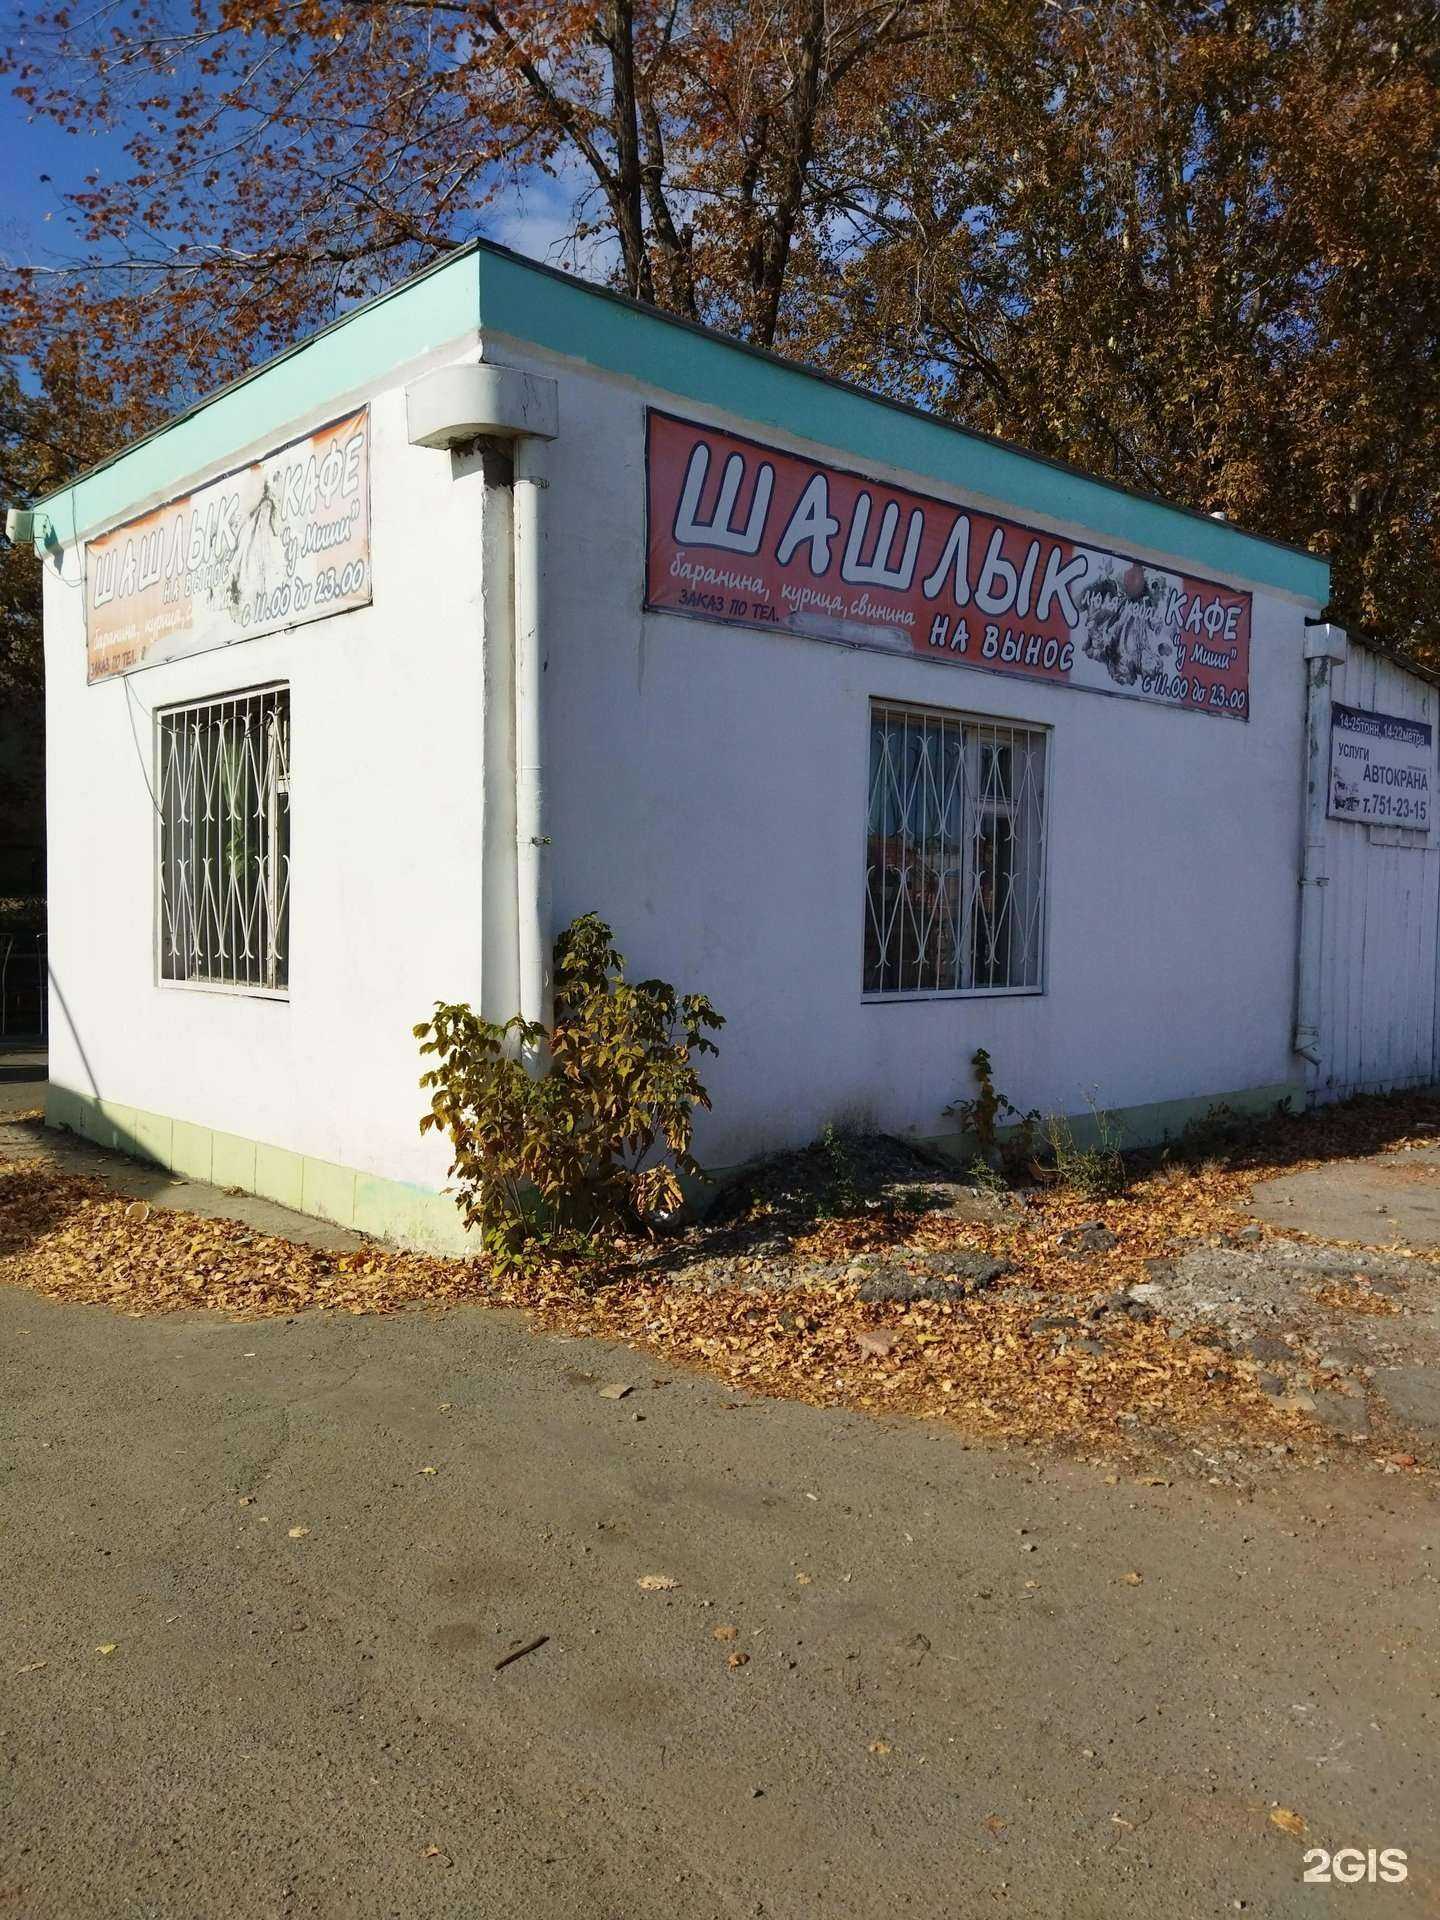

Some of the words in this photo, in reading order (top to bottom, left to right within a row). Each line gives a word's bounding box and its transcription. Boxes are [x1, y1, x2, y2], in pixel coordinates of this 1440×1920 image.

[281, 432, 364, 522] КАФЕ
[94, 493, 240, 609] ШАШЛЫК
[672, 440, 1088, 629] ШАШЛЫК
[254, 584, 291, 623] 11.00
[293, 576, 312, 611] до
[314, 558, 364, 604] 23.00
[669, 551, 770, 601] баранина,
[678, 588, 725, 612] ЗАКАЗ
[729, 597, 747, 617] ПО
[752, 603, 780, 623] ТЕЛ.
[1165, 588, 1243, 640] КАФЕ
[930, 611, 970, 653] НА
[982, 624, 1075, 672] ВЫНОС
[1154, 673, 1189, 699] 11.00
[1192, 676, 1207, 702] до
[1209, 682, 1247, 710] 23.00
[1338, 742, 1370, 761] УСЛУГИ
[1363, 763, 1428, 791] АВТОКРАНА
